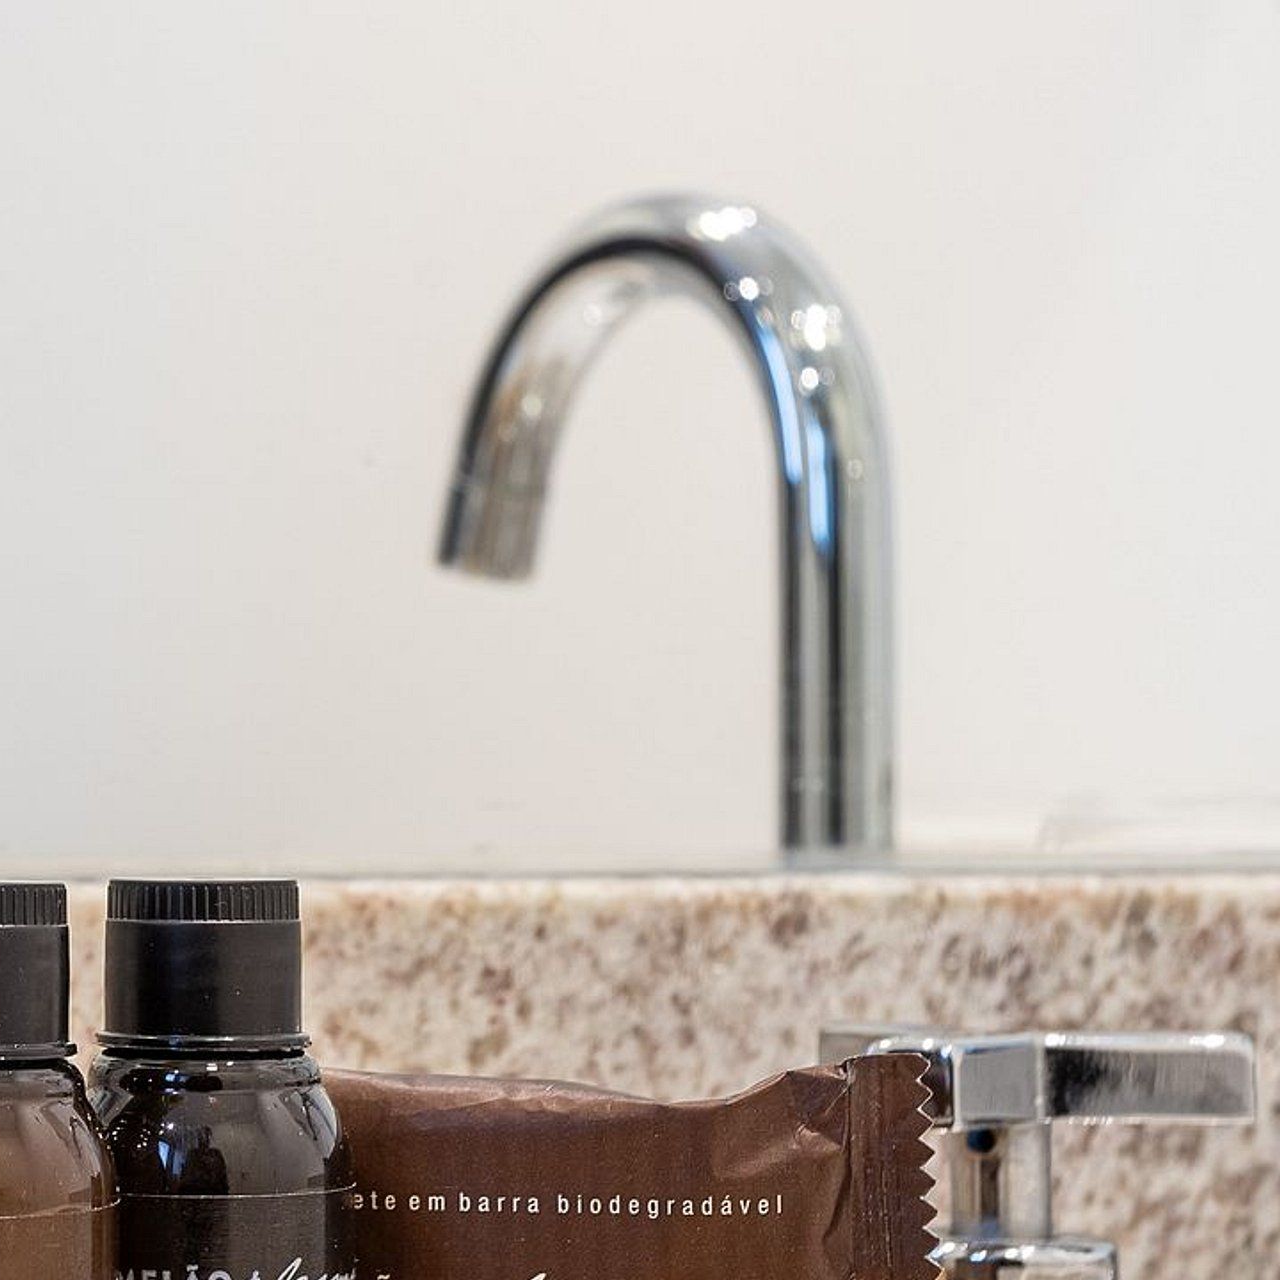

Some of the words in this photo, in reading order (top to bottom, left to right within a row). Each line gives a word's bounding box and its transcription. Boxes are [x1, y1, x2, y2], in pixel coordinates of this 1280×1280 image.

[409, 1194, 446, 1211] em
[458, 1192, 540, 1213] barra
[557, 1193, 783, 1219] biodegradável
